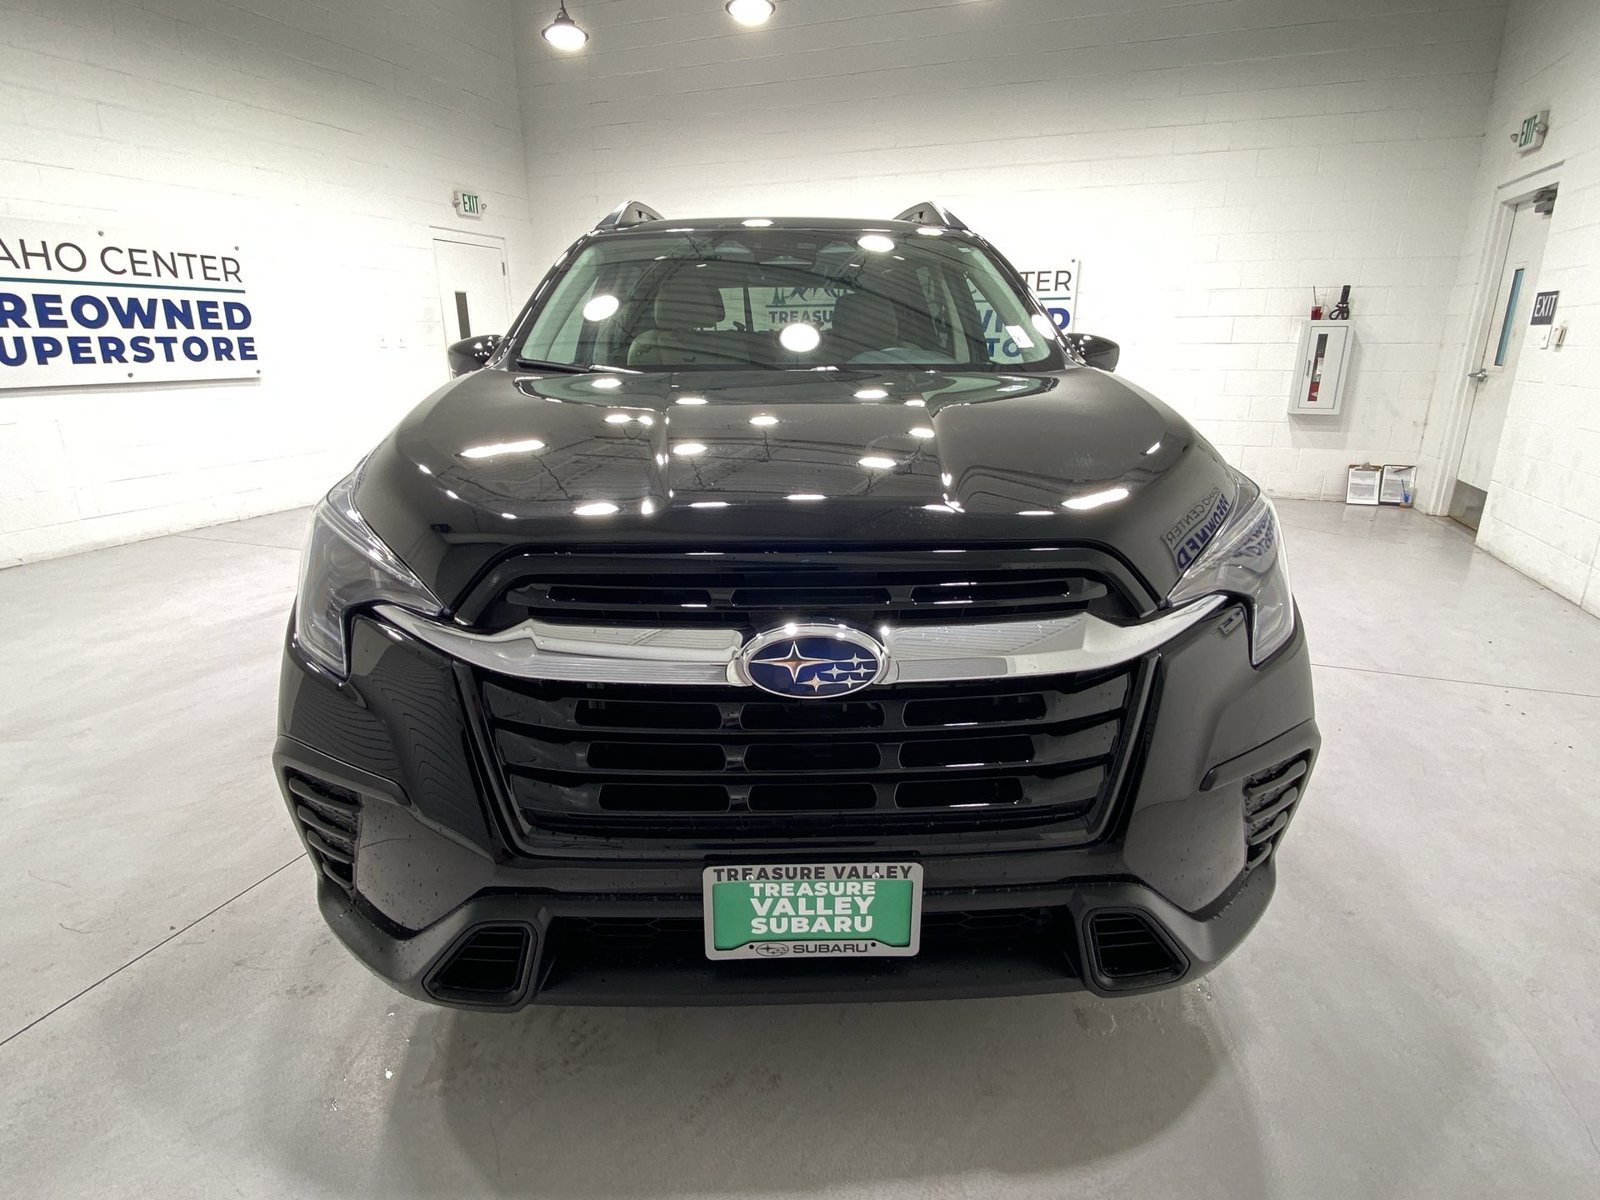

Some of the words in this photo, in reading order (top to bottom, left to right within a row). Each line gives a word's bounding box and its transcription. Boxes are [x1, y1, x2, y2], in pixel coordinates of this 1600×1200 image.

[1519, 115, 1538, 148] EXIT
[462, 193, 479, 214] EXIT
[100, 246, 243, 283] CENTER
[0, 292, 252, 330] REOWNED
[1534, 294, 1558, 317] EXIT
[0, 336, 259, 367] UPERSTORE
[713, 867, 825, 881] TREASURE
[833, 866, 912, 880] VALLEY
[750, 882, 876, 896] TREASURE
[750, 896, 875, 916] VALLEY
[751, 916, 873, 934] SUBARU
[793, 943, 868, 953] SUBARU
